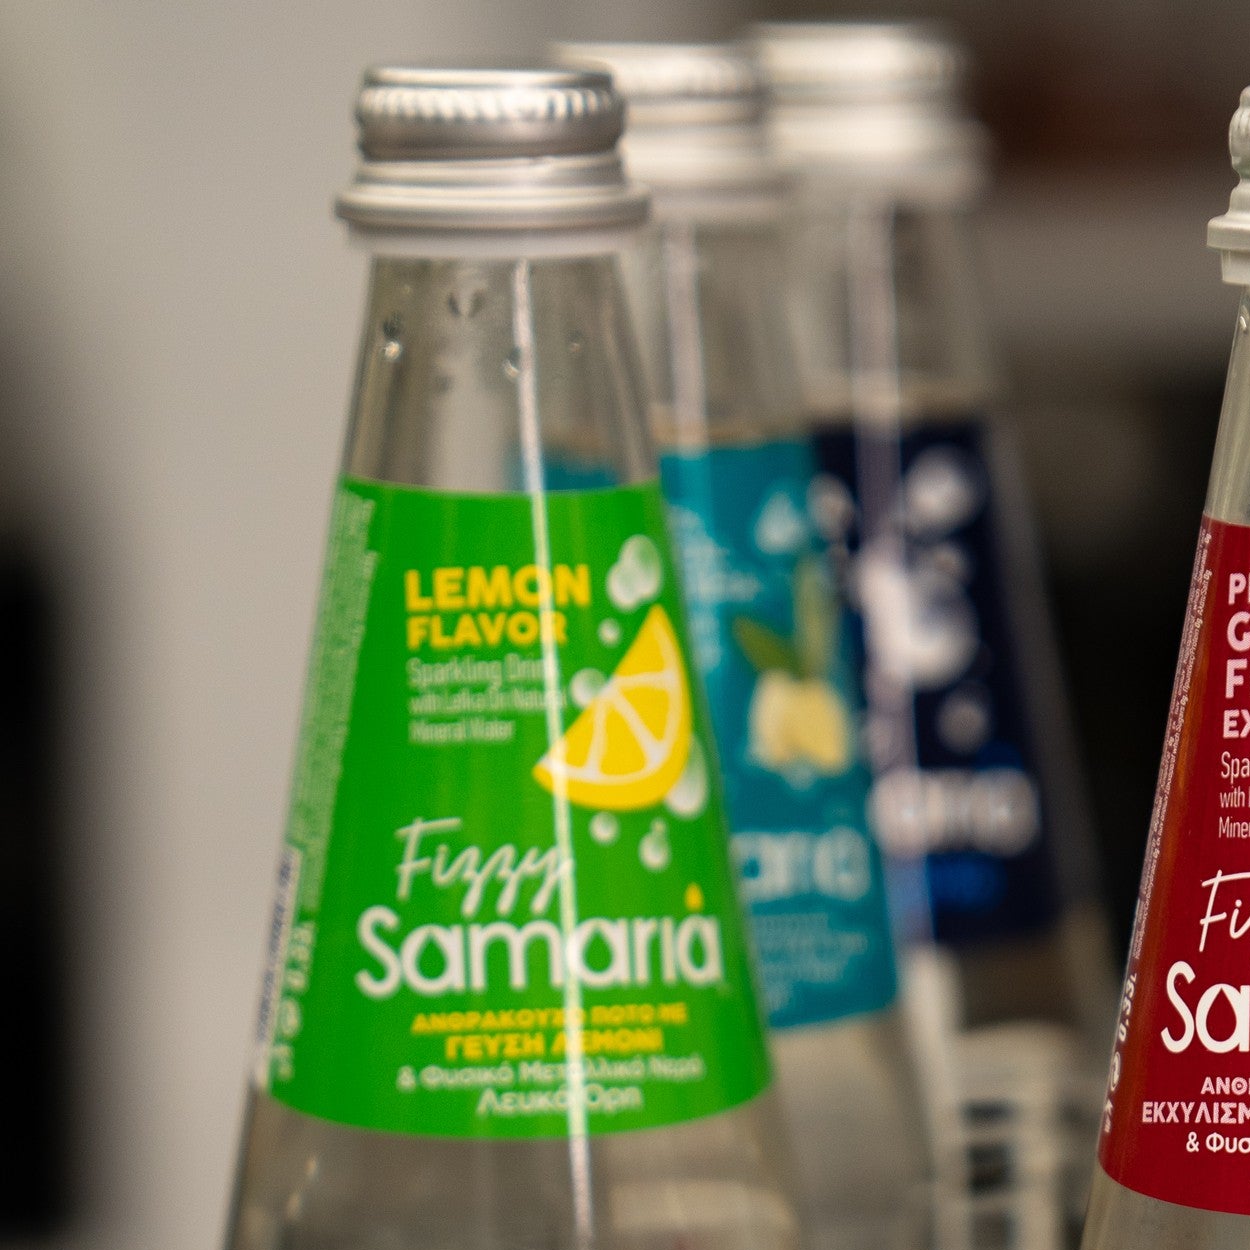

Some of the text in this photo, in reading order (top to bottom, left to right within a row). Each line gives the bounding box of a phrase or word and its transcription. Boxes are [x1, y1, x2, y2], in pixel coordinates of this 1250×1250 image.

[404, 564, 592, 611] LEMON
[407, 611, 568, 650] FLAVOR
[1220, 787, 1245, 808] with
[397, 817, 574, 917] Fizzy
[1186, 1132, 1200, 1153] &
